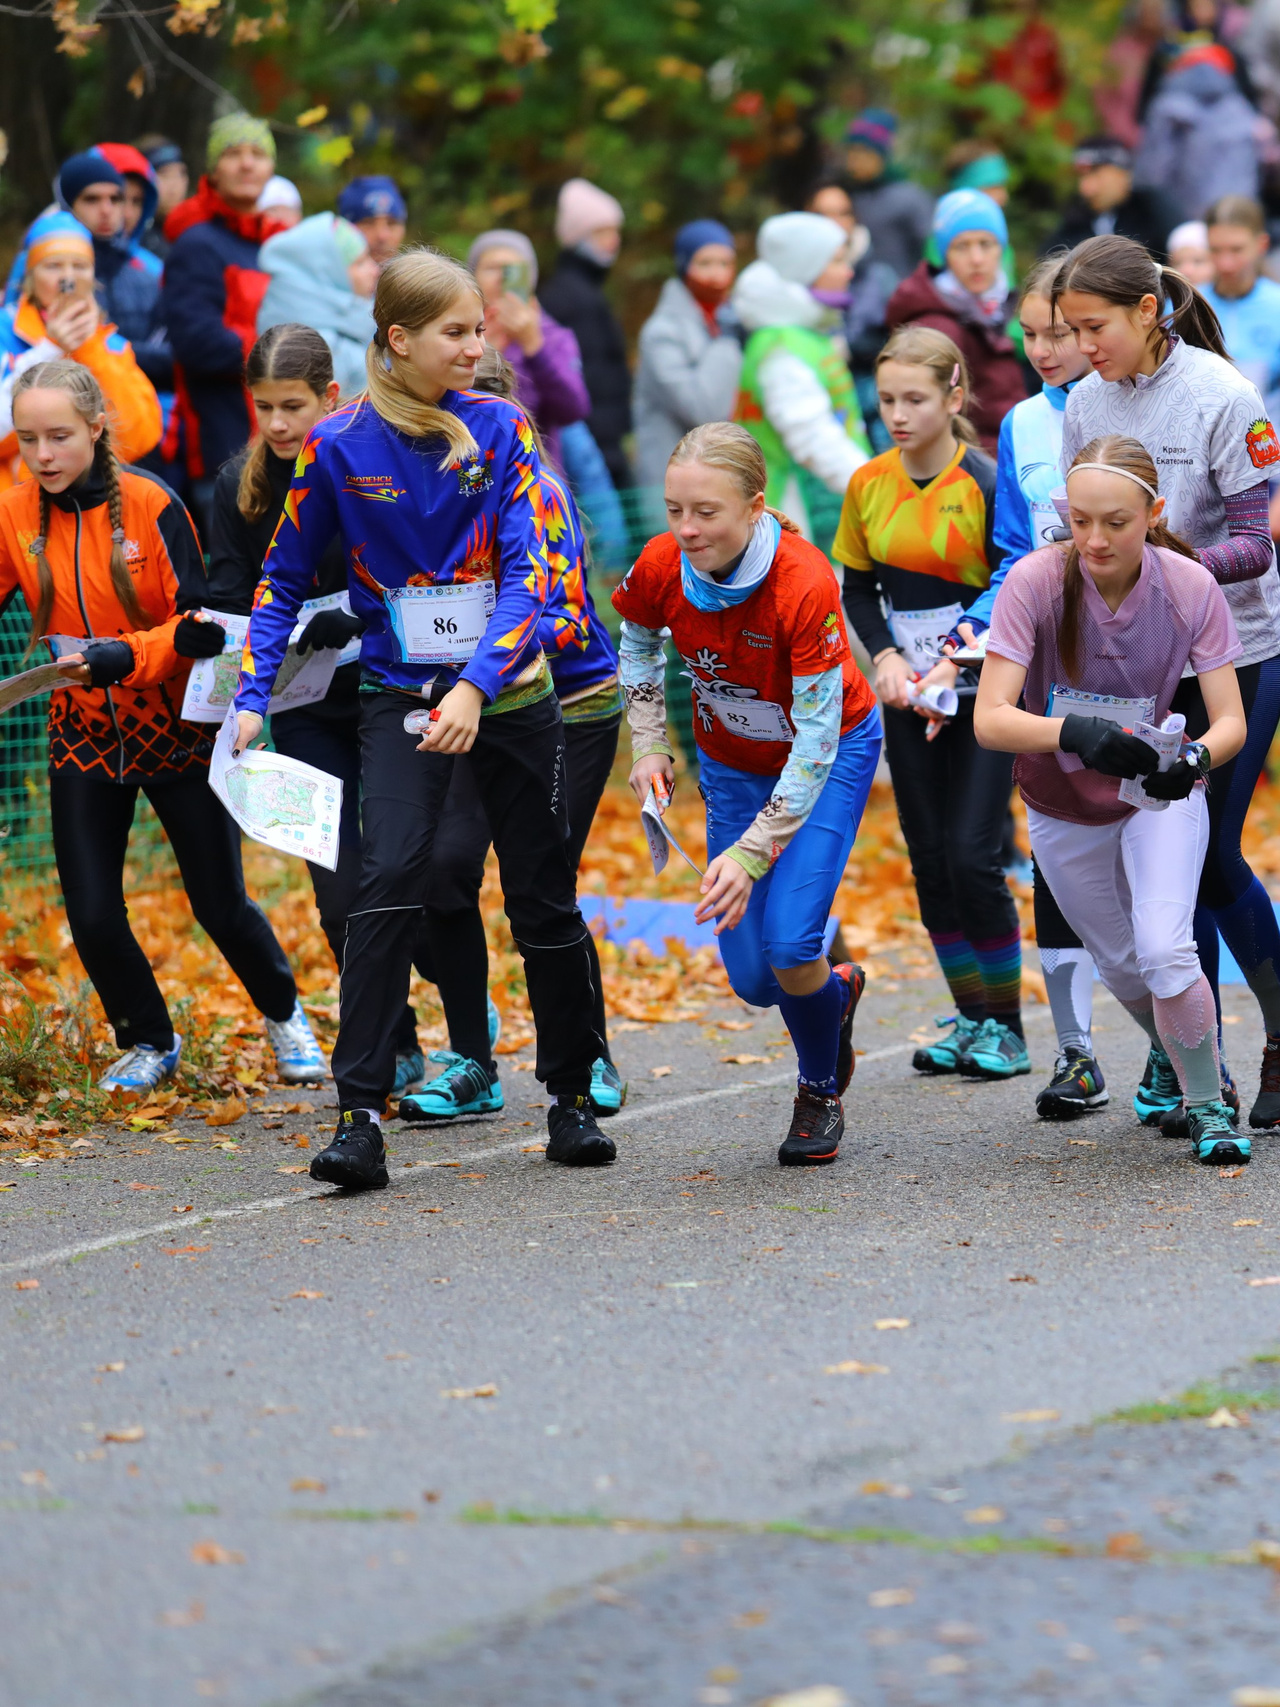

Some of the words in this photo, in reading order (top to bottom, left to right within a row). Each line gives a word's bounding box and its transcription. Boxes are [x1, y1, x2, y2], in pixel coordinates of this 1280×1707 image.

[1156, 457, 1193, 465] Екатерина
[345, 475, 393, 483] СМОЛЕНСК
[940, 505, 963, 513] ARS
[433, 616, 458, 635] 86
[914, 638, 934, 652] 85
[727, 712, 750, 727] 82
[302, 846, 322, 858] 86.1
